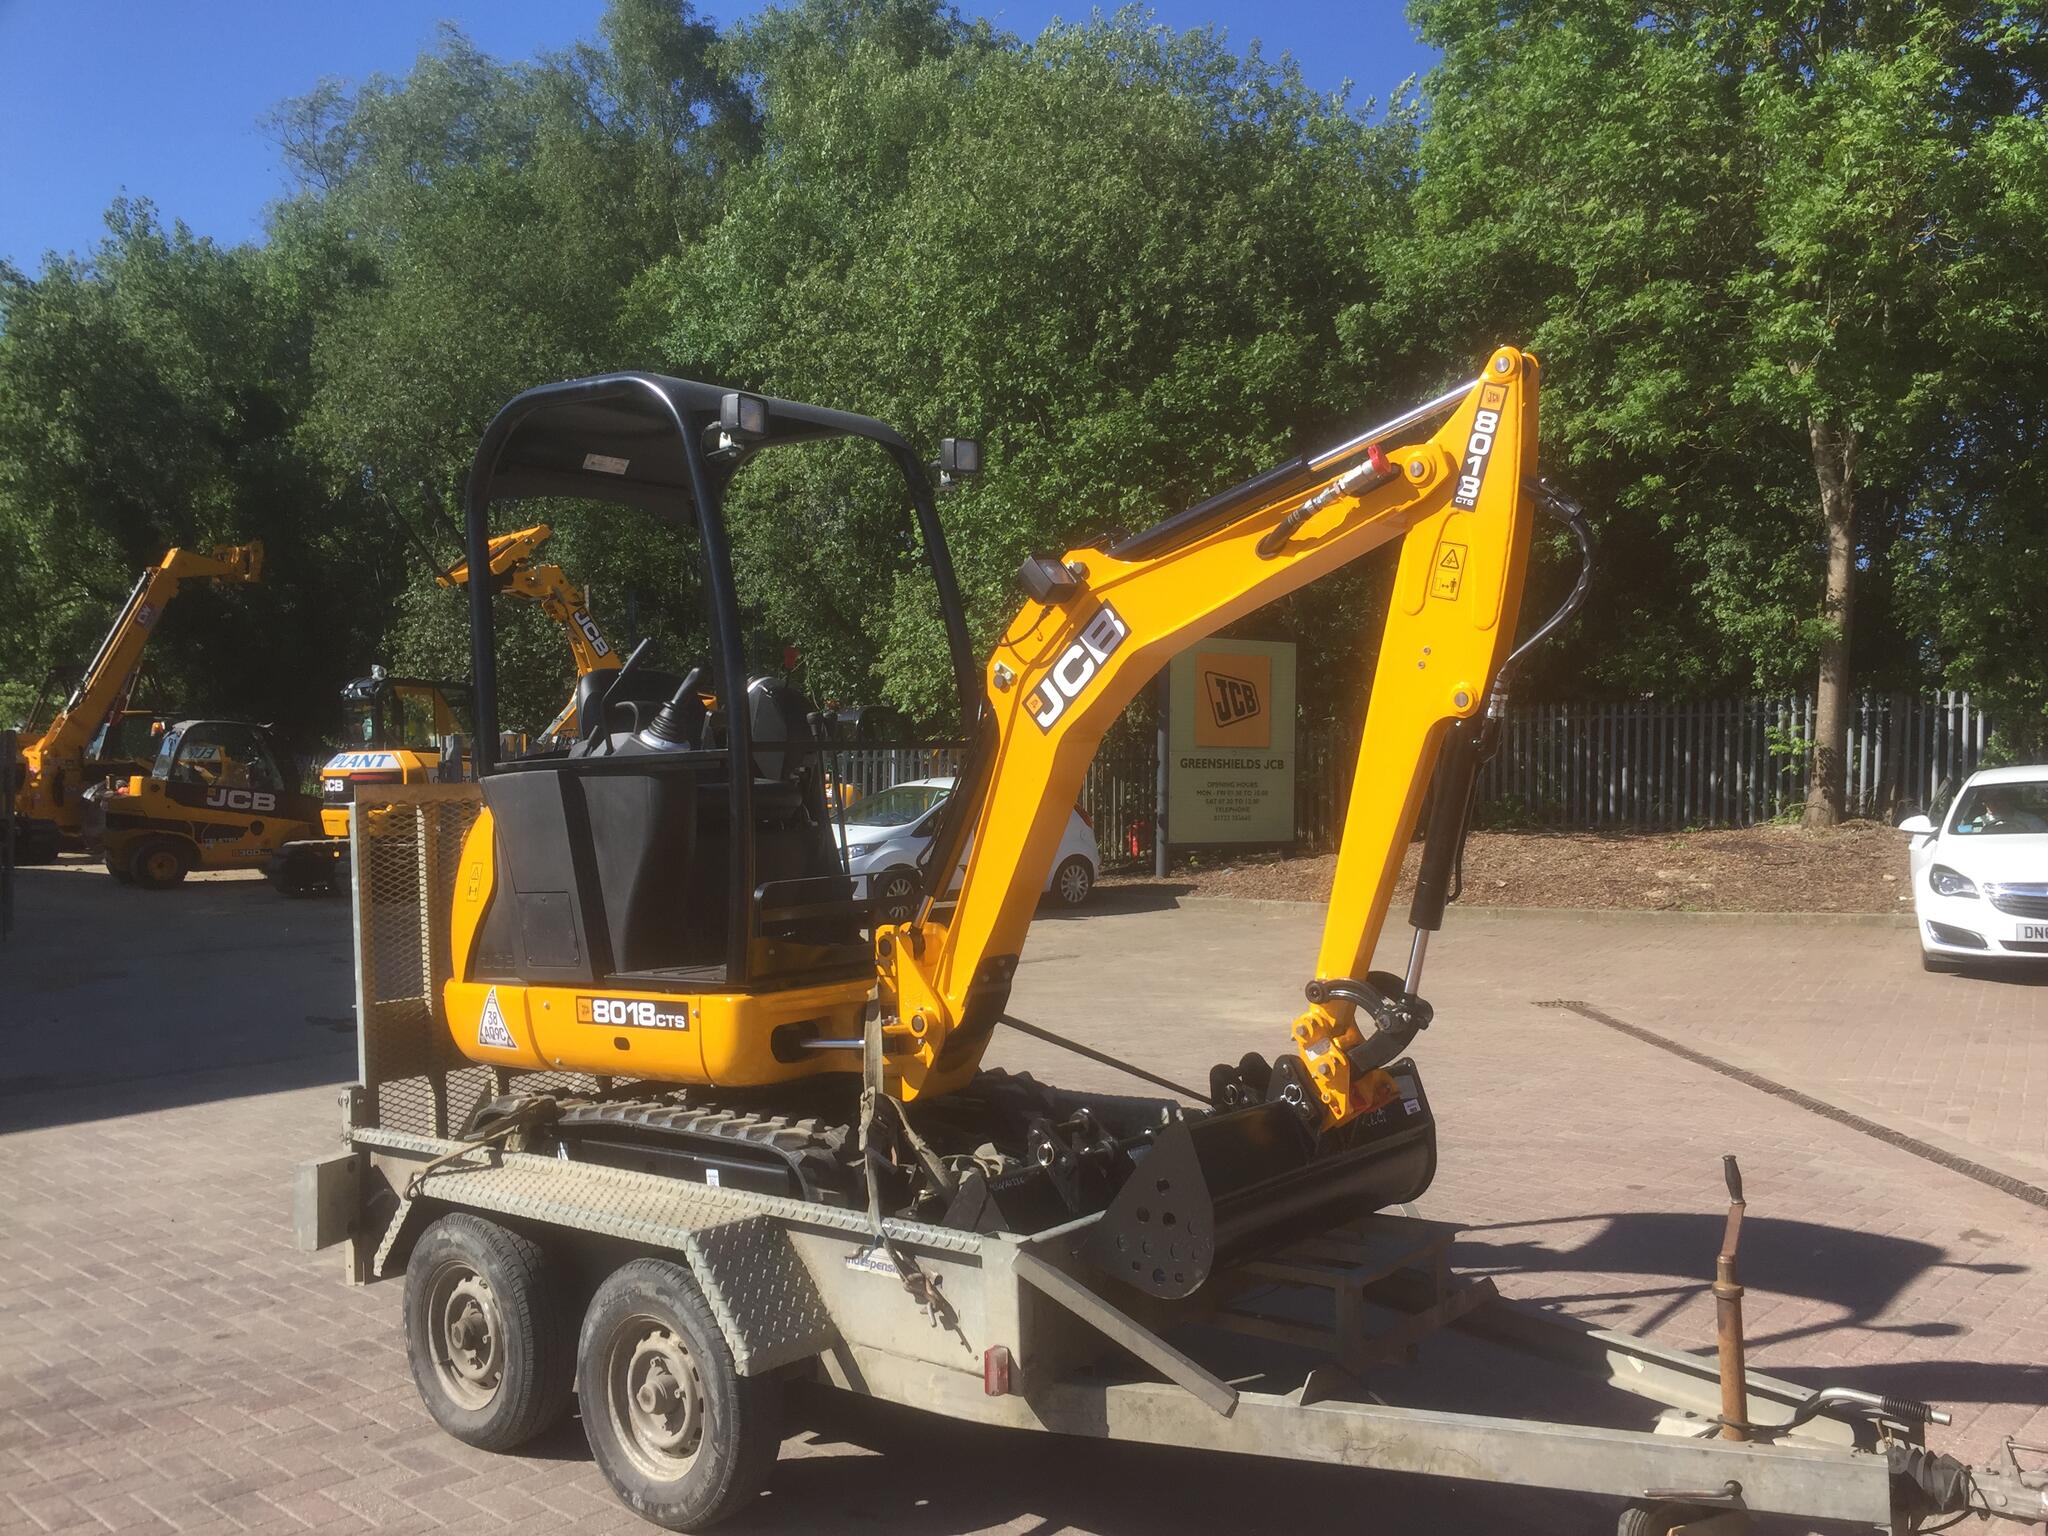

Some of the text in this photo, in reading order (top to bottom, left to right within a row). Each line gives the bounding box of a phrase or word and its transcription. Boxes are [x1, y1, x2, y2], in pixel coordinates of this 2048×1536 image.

[1457, 410, 1499, 498] 8018
[1455, 496, 1474, 506] CTS
[574, 612, 609, 656] JCB
[1036, 608, 1126, 728] JCB
[1215, 678, 1257, 722] JCB
[331, 754, 391, 768] PLANT
[1180, 758, 1284, 770] GREENSHIELDS JCB
[206, 789, 276, 811] JCB
[487, 1011, 498, 1026] 38
